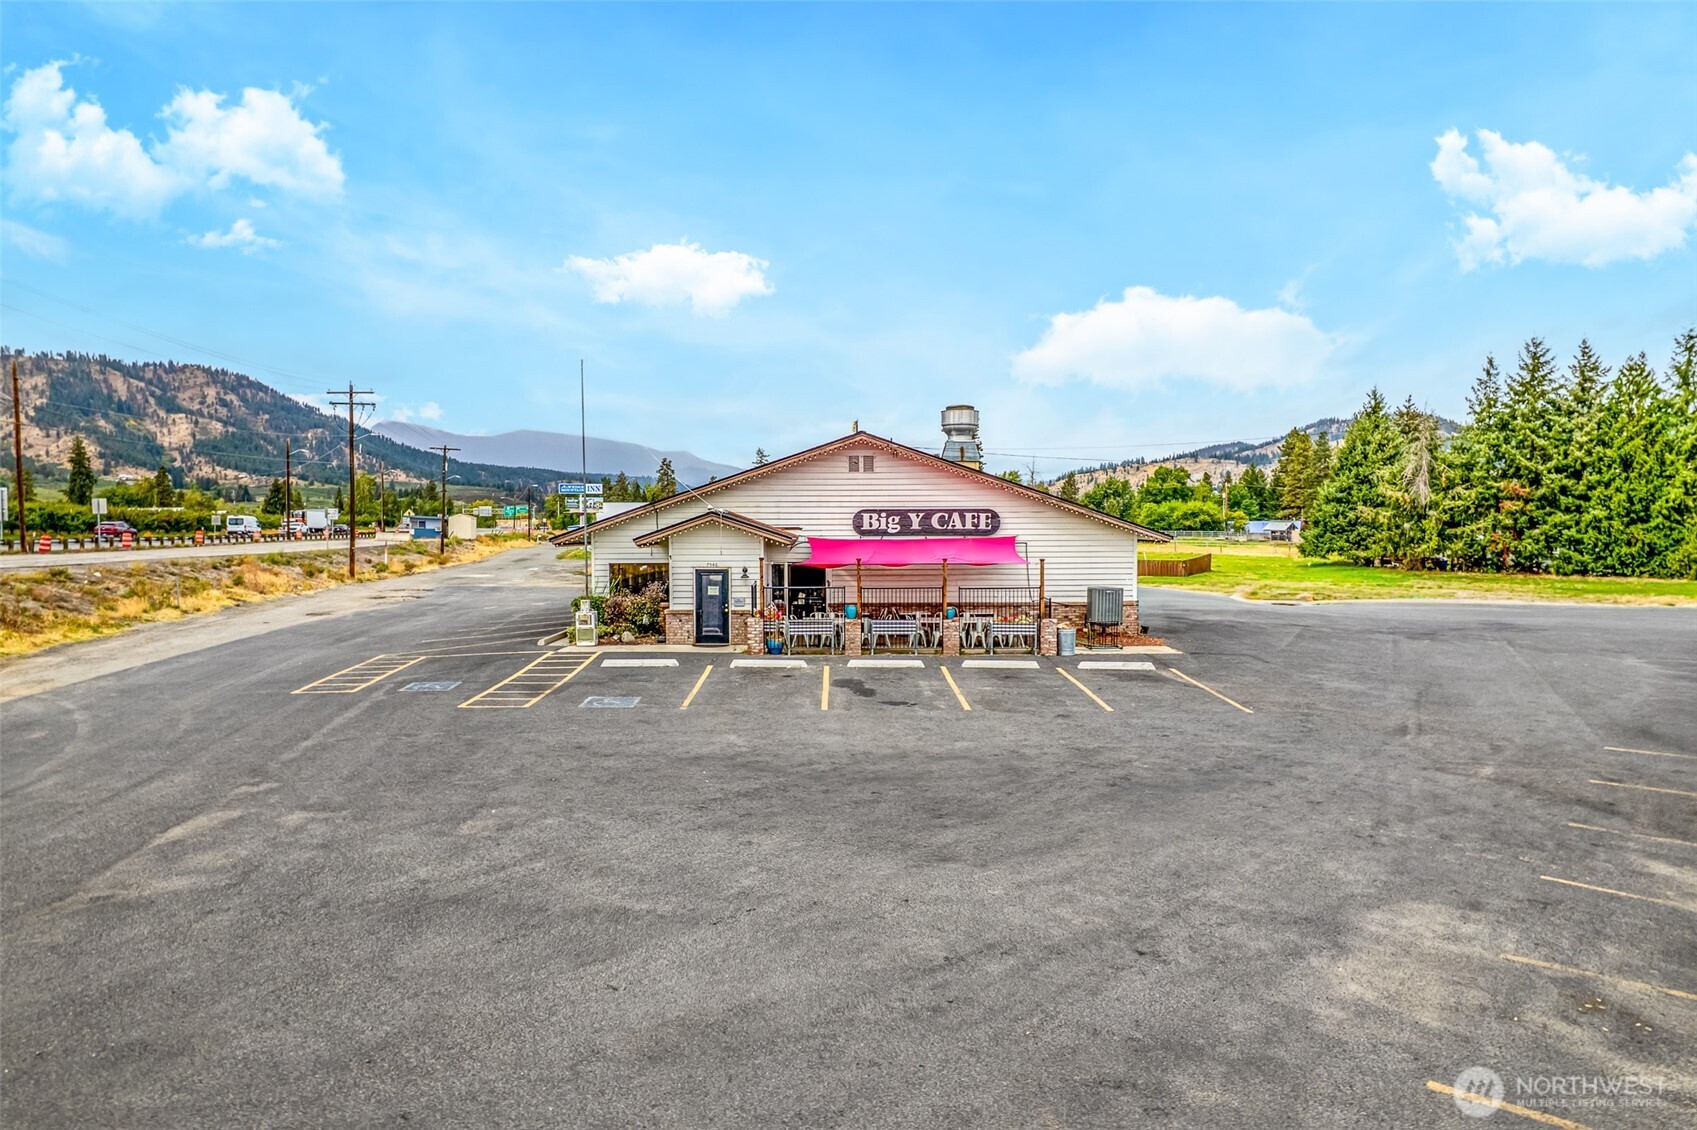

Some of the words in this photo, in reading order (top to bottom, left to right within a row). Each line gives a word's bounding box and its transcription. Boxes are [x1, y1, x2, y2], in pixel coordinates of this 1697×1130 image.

[860, 512, 901, 533] Big
[907, 512, 926, 530] Y
[931, 512, 992, 530] CAFE
